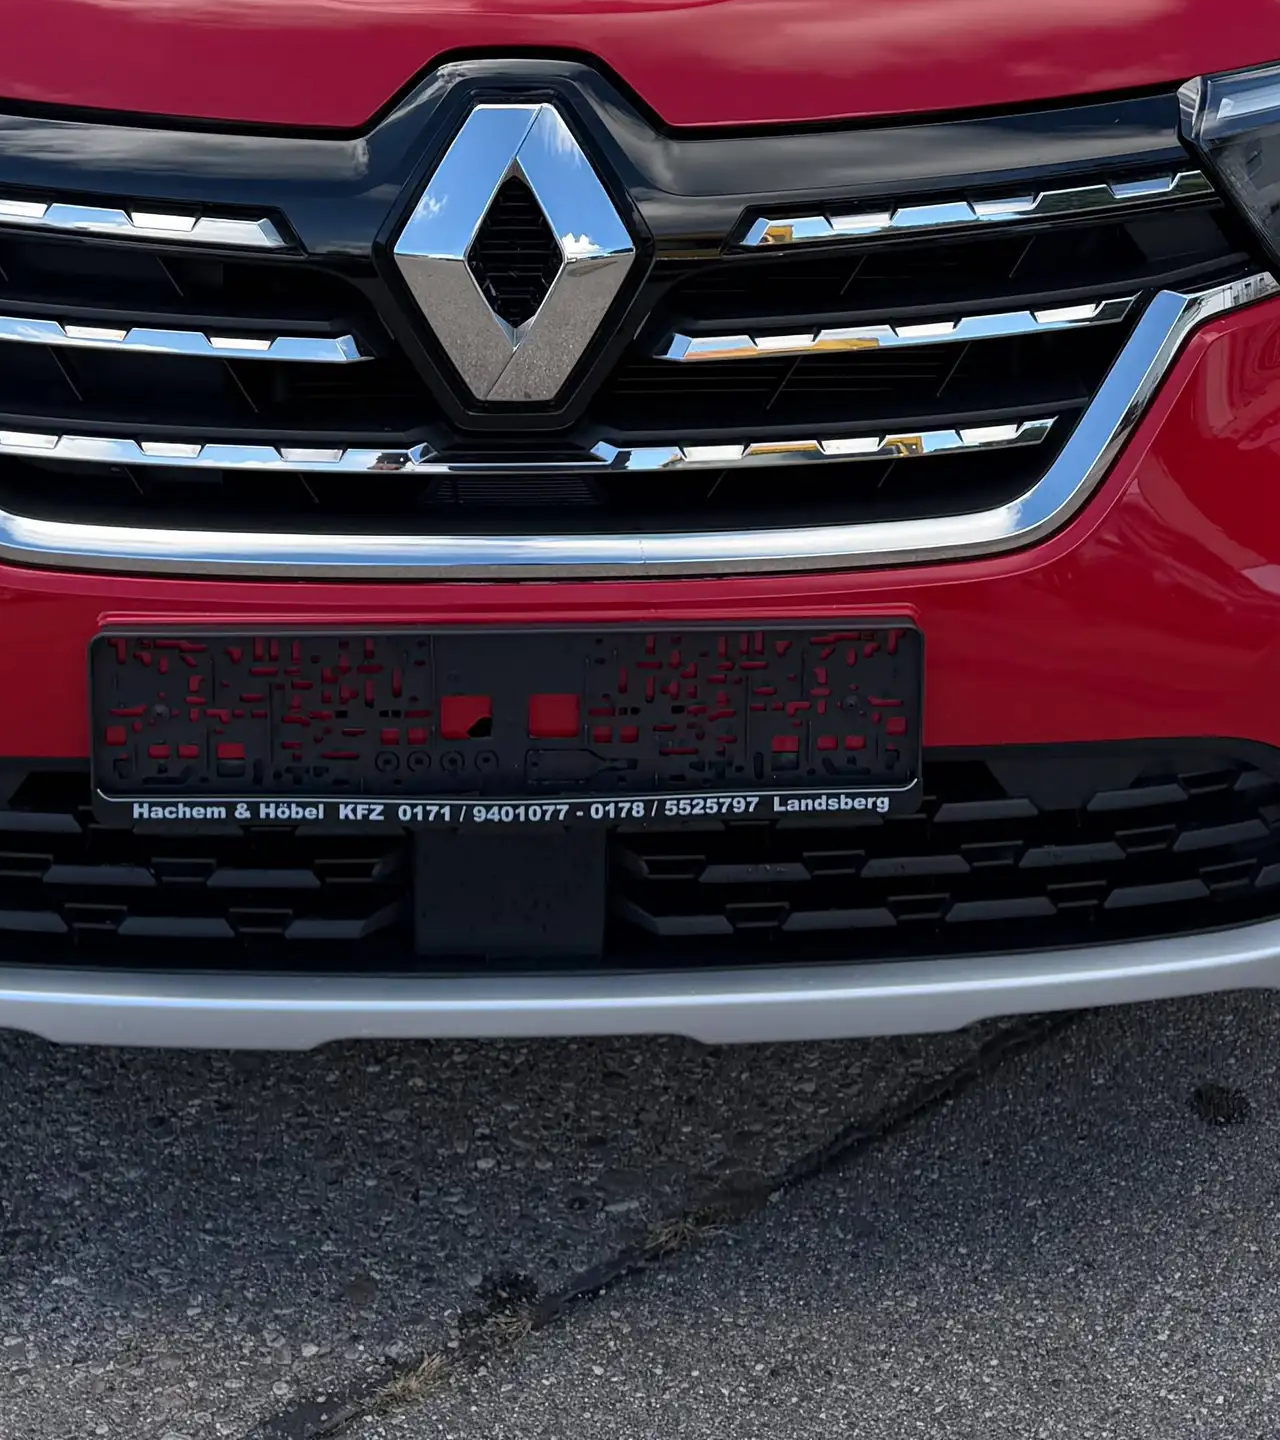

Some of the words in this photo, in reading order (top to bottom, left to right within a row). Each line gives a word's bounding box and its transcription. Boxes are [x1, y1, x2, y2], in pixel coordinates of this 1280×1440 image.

[133, 802, 227, 819] Hachem
[234, 802, 251, 819] &
[259, 803, 324, 820] Höbel
[339, 803, 385, 821] KFZ
[397, 804, 451, 822] 0171
[472, 804, 570, 822] 9401077
[590, 801, 645, 820] 0178
[664, 796, 760, 816] 5525797
[773, 794, 890, 813] Landsberg
